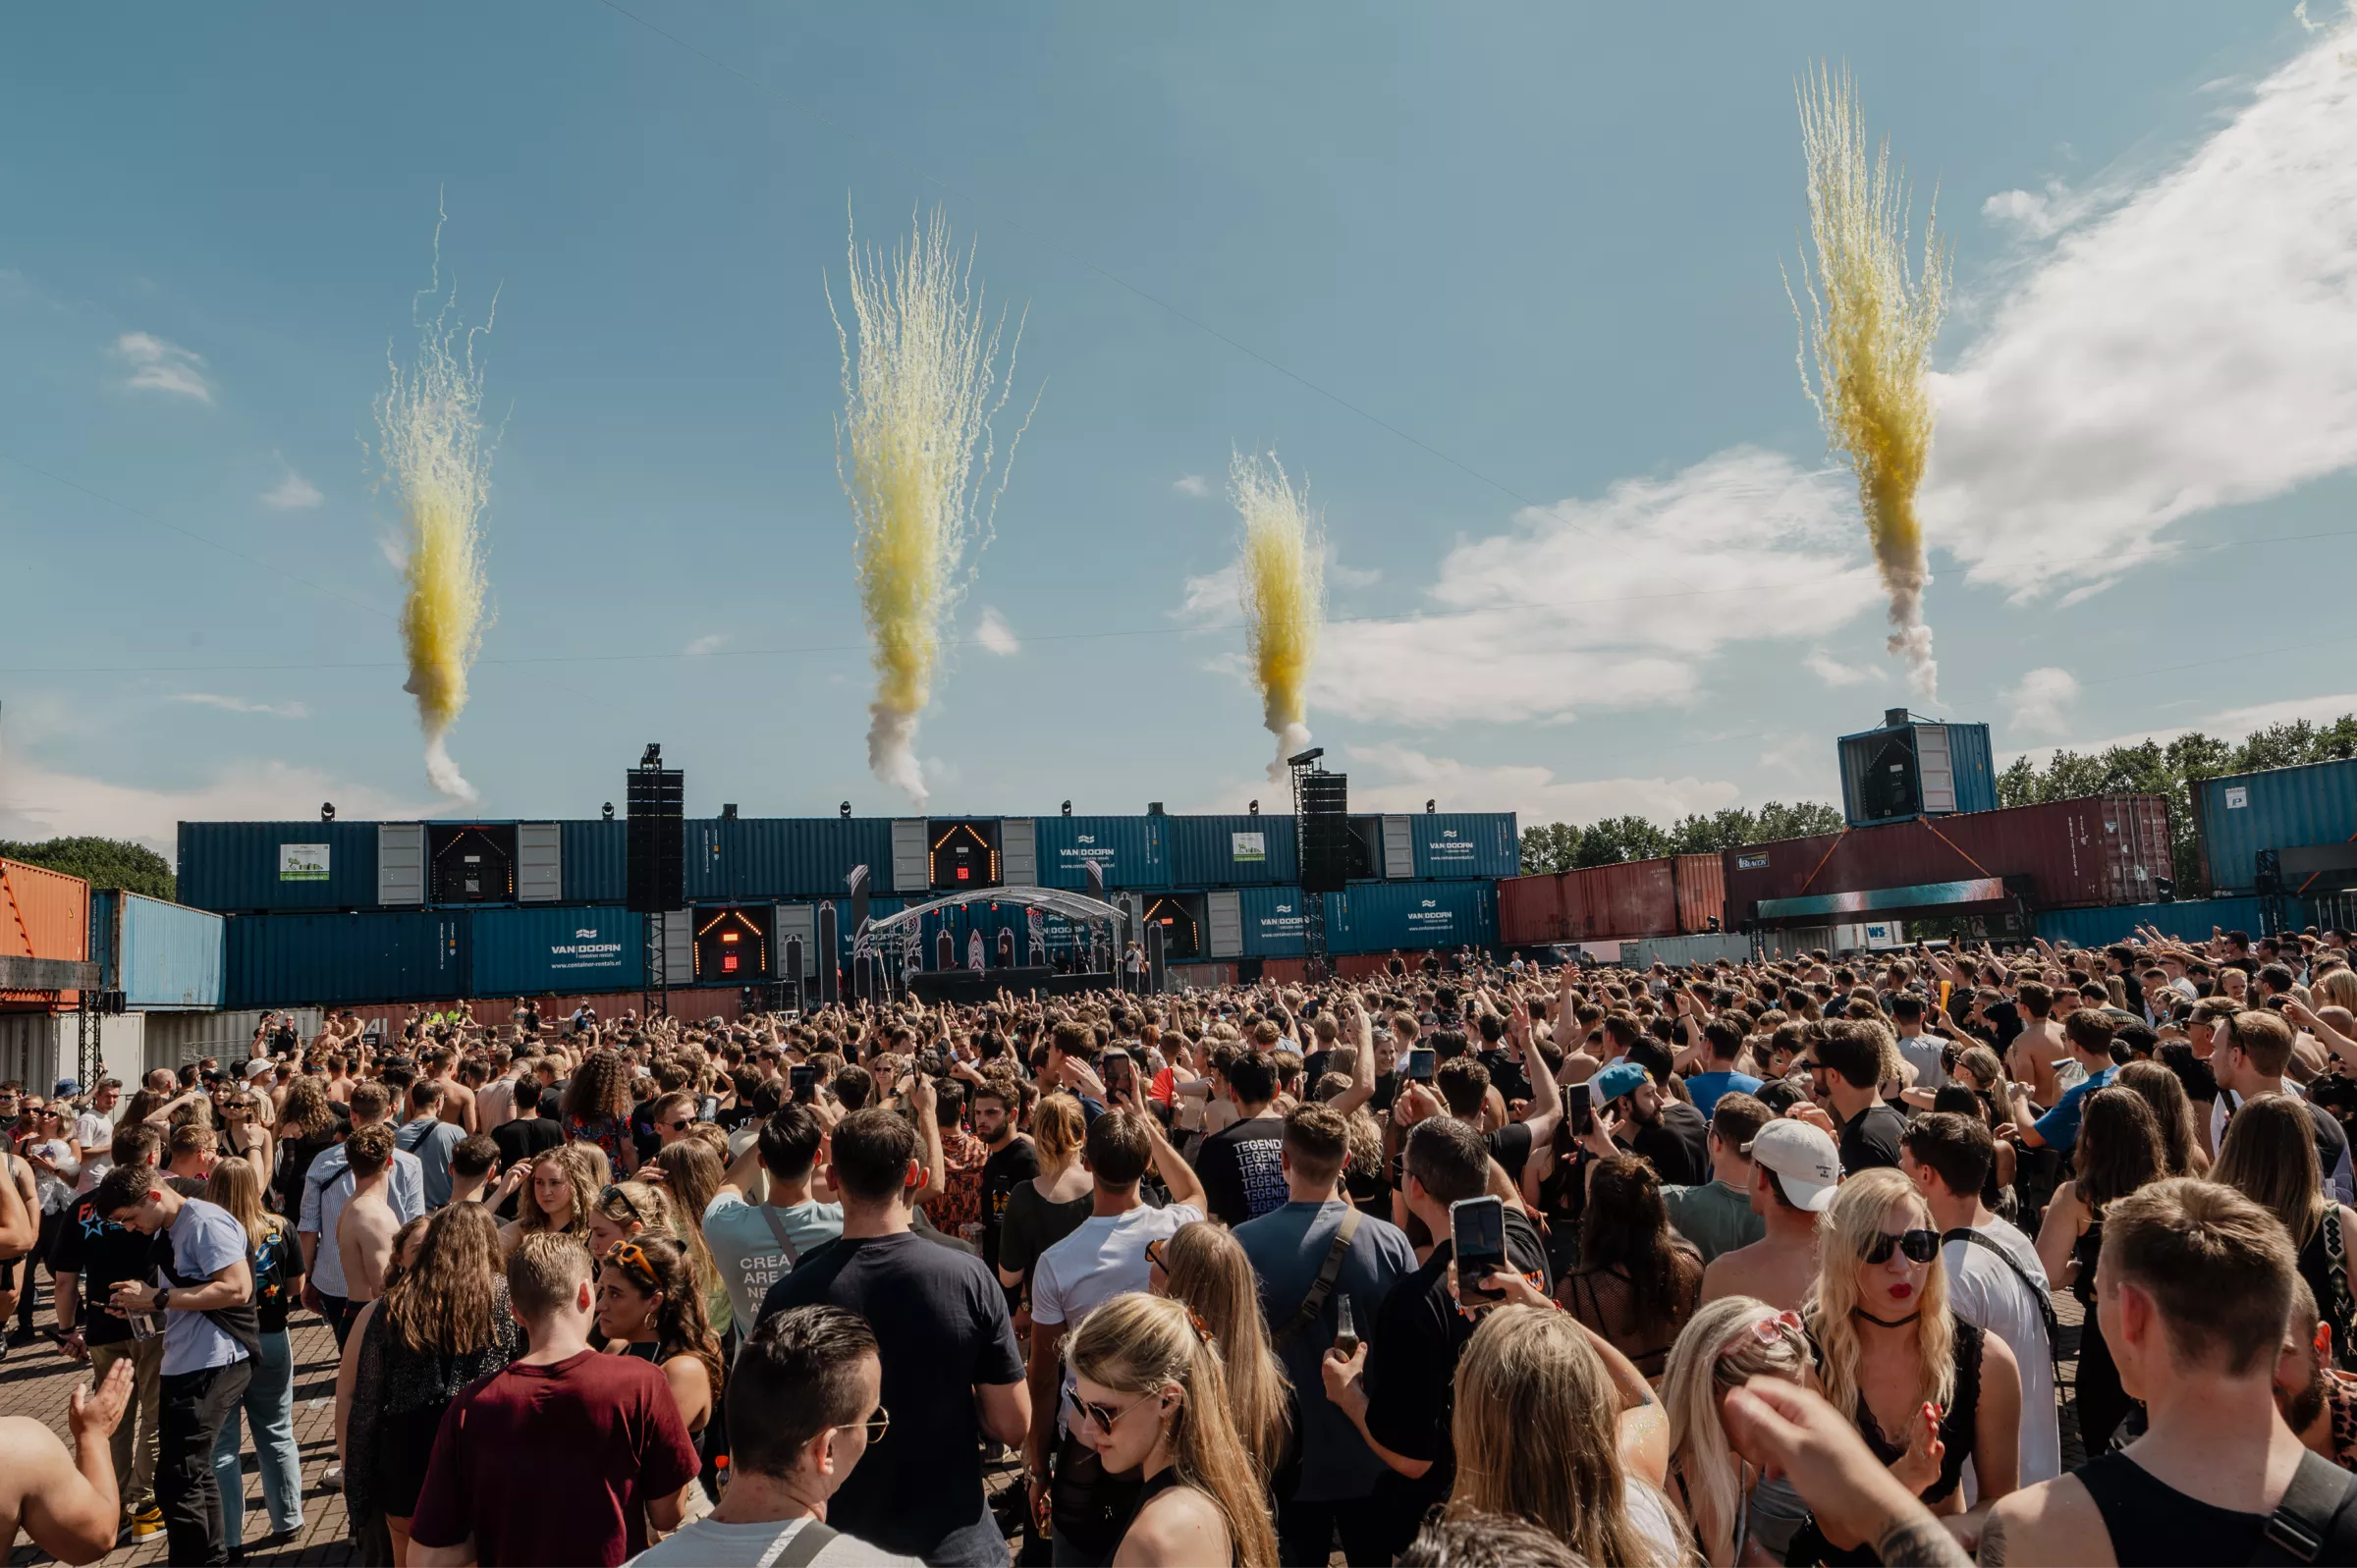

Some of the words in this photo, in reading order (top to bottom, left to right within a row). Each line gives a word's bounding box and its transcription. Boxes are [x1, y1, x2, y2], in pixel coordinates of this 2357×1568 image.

[1742, 859, 1767, 868] BEACON
[551, 946, 576, 954] VAN
[577, 944, 622, 953] DOORN
[551, 960, 622, 969] www.container-rentals.nl
[1233, 1139, 1284, 1155] TEGEND
[743, 1271, 779, 1284] ARE
